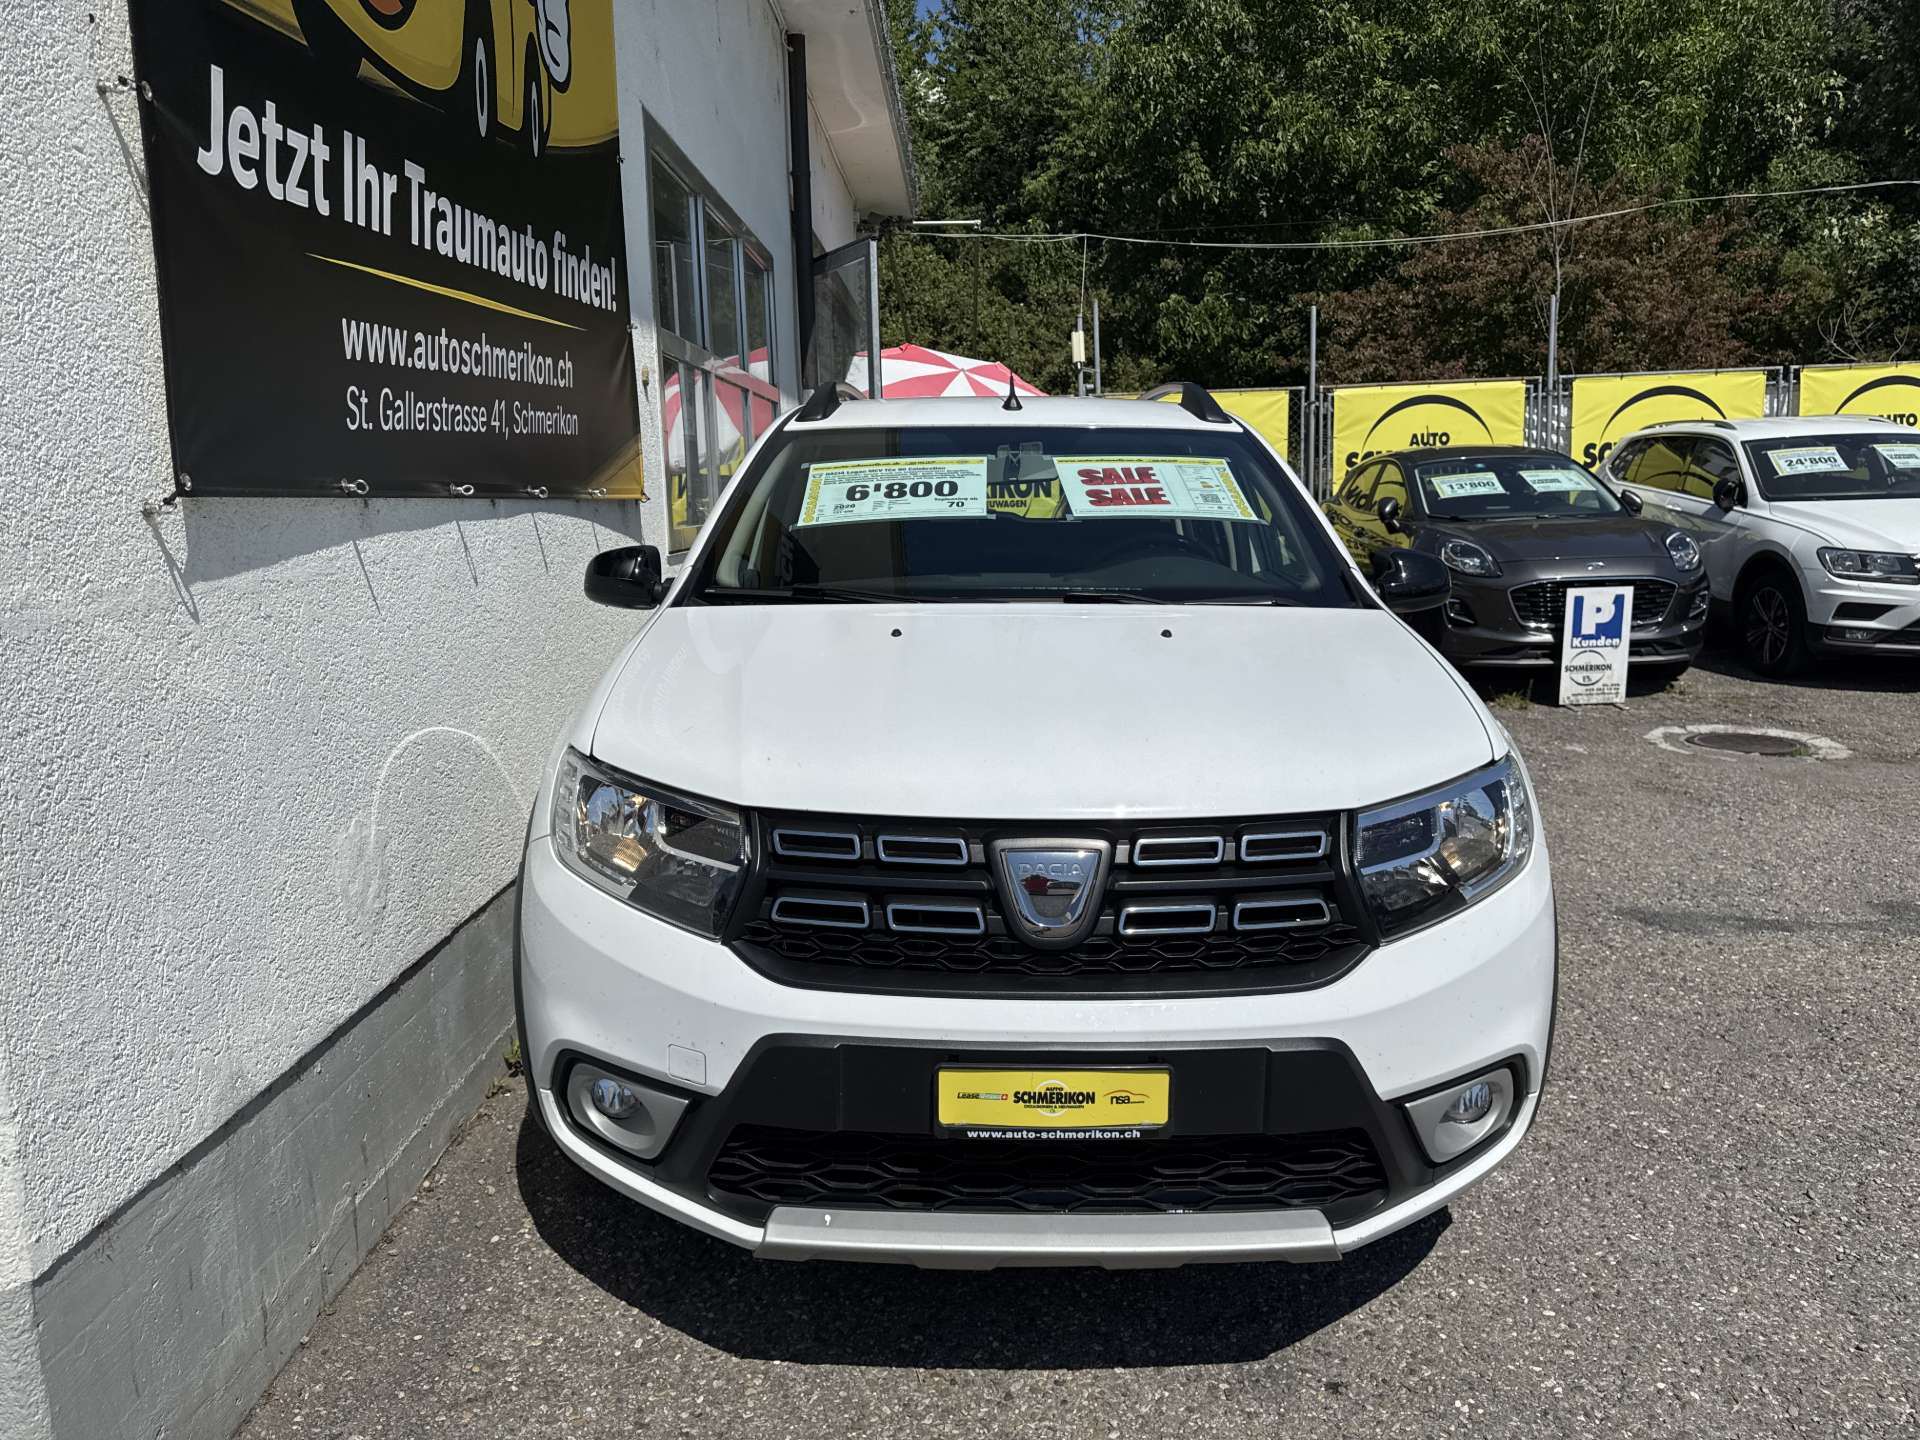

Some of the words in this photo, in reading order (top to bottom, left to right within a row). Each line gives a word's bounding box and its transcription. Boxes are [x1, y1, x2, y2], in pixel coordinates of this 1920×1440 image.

[197, 64, 330, 216] Jetzt
[344, 130, 398, 236] Ihr
[405, 159, 548, 290] Traumauto
[553, 230, 616, 312] finden!
[342, 317, 574, 388] www.autoschmerikon.ch
[346, 385, 373, 430] St.
[379, 387, 487, 431] Gallerstrasse
[490, 399, 510, 440] 41,
[513, 401, 579, 435] Schmerikon
[1878, 412, 1918, 427] UTO
[1409, 432, 1450, 446] AUTO
[1077, 467, 1161, 485] SALE
[846, 481, 959, 501] 6'800
[1447, 480, 1496, 491] 13'800
[1085, 488, 1172, 506] SALE
[1572, 636, 1620, 649] Kunden
[1564, 663, 1612, 673] SCHMERIKON
[1018, 863, 1084, 876] DACIA
[1013, 1091, 1096, 1105] SCHMERIKON
[1110, 1095, 1131, 1105] nsa
[966, 1128, 1142, 1139] www.auto-schmerikon.ch
